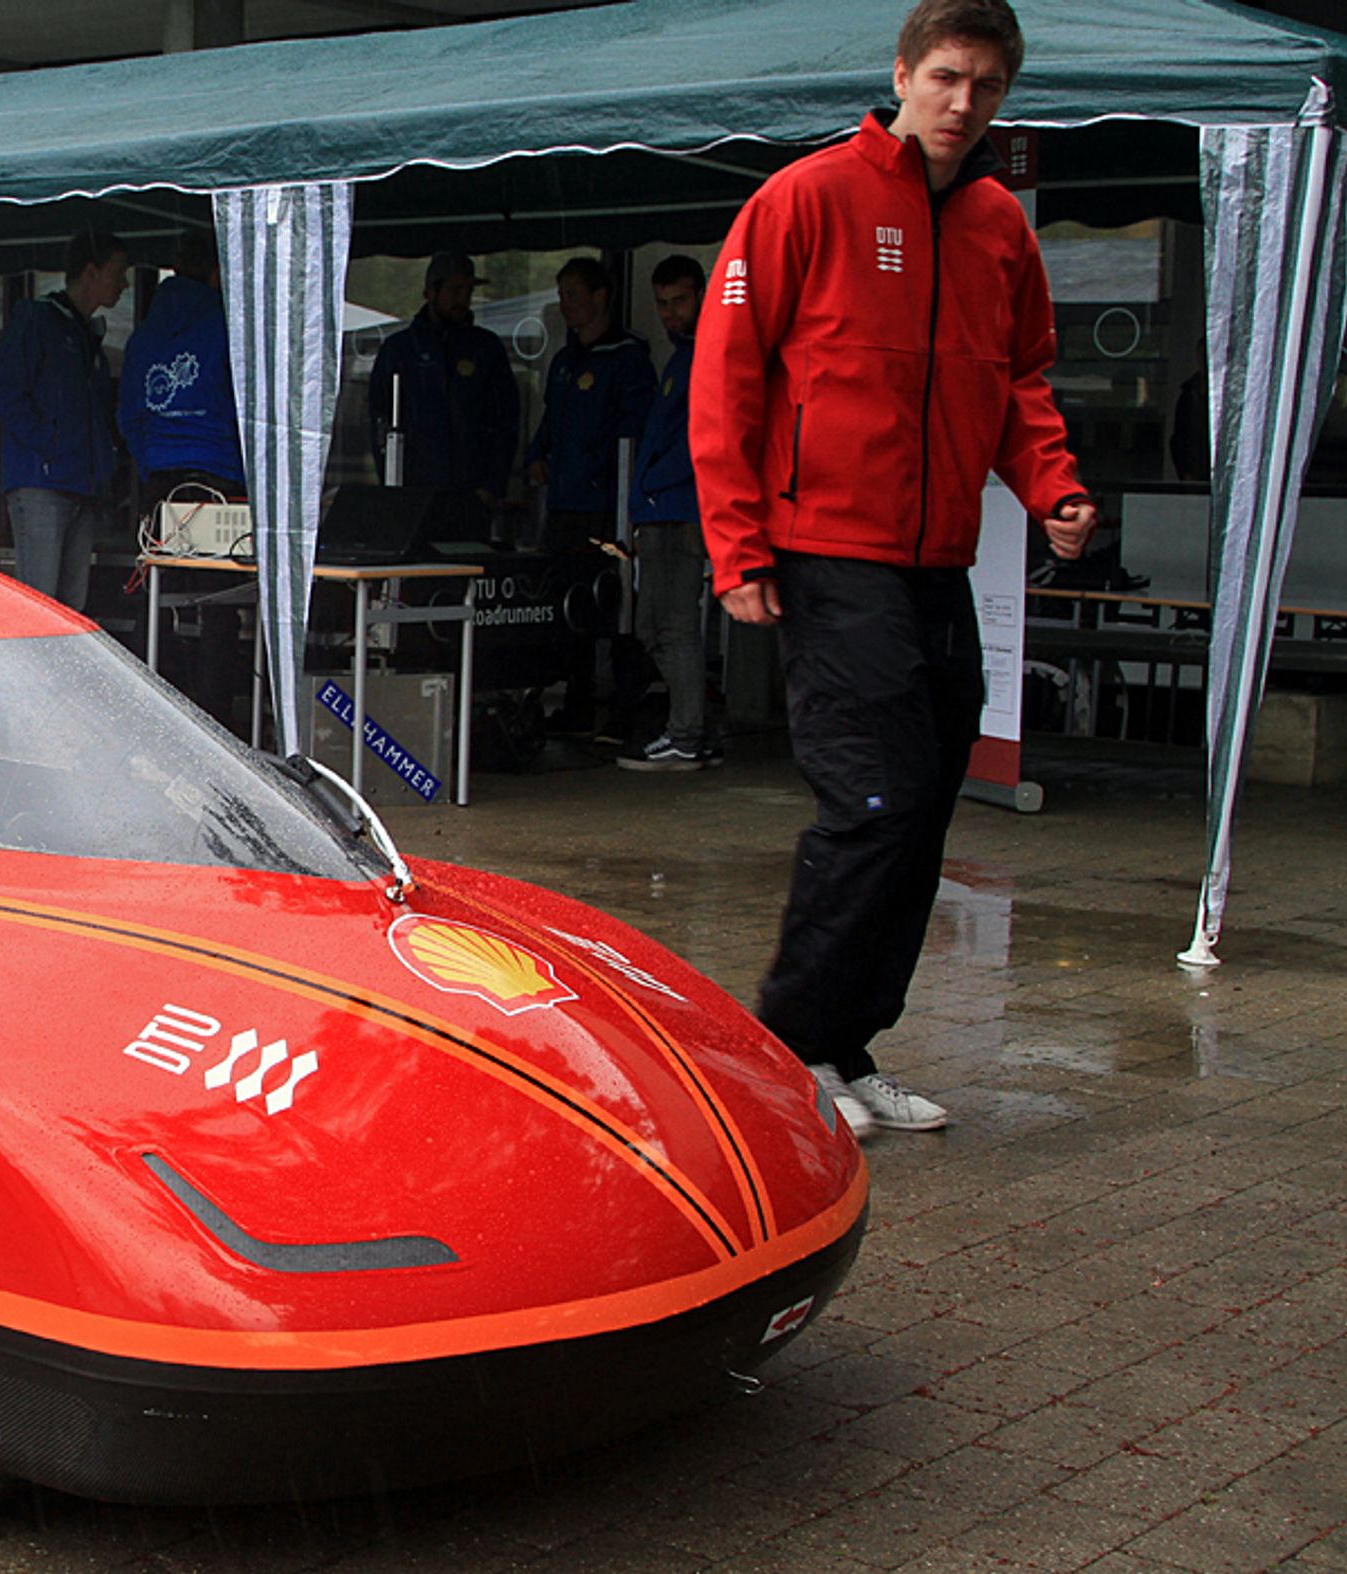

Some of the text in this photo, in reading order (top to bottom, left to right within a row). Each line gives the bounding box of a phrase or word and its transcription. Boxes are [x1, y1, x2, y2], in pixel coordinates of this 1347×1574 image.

[876, 226, 902, 246] DTU
[474, 578, 496, 600] TU
[470, 604, 555, 626] oadrunners
[320, 685, 435, 797] ELLHAMMER
[123, 1003, 221, 1075] DTU
